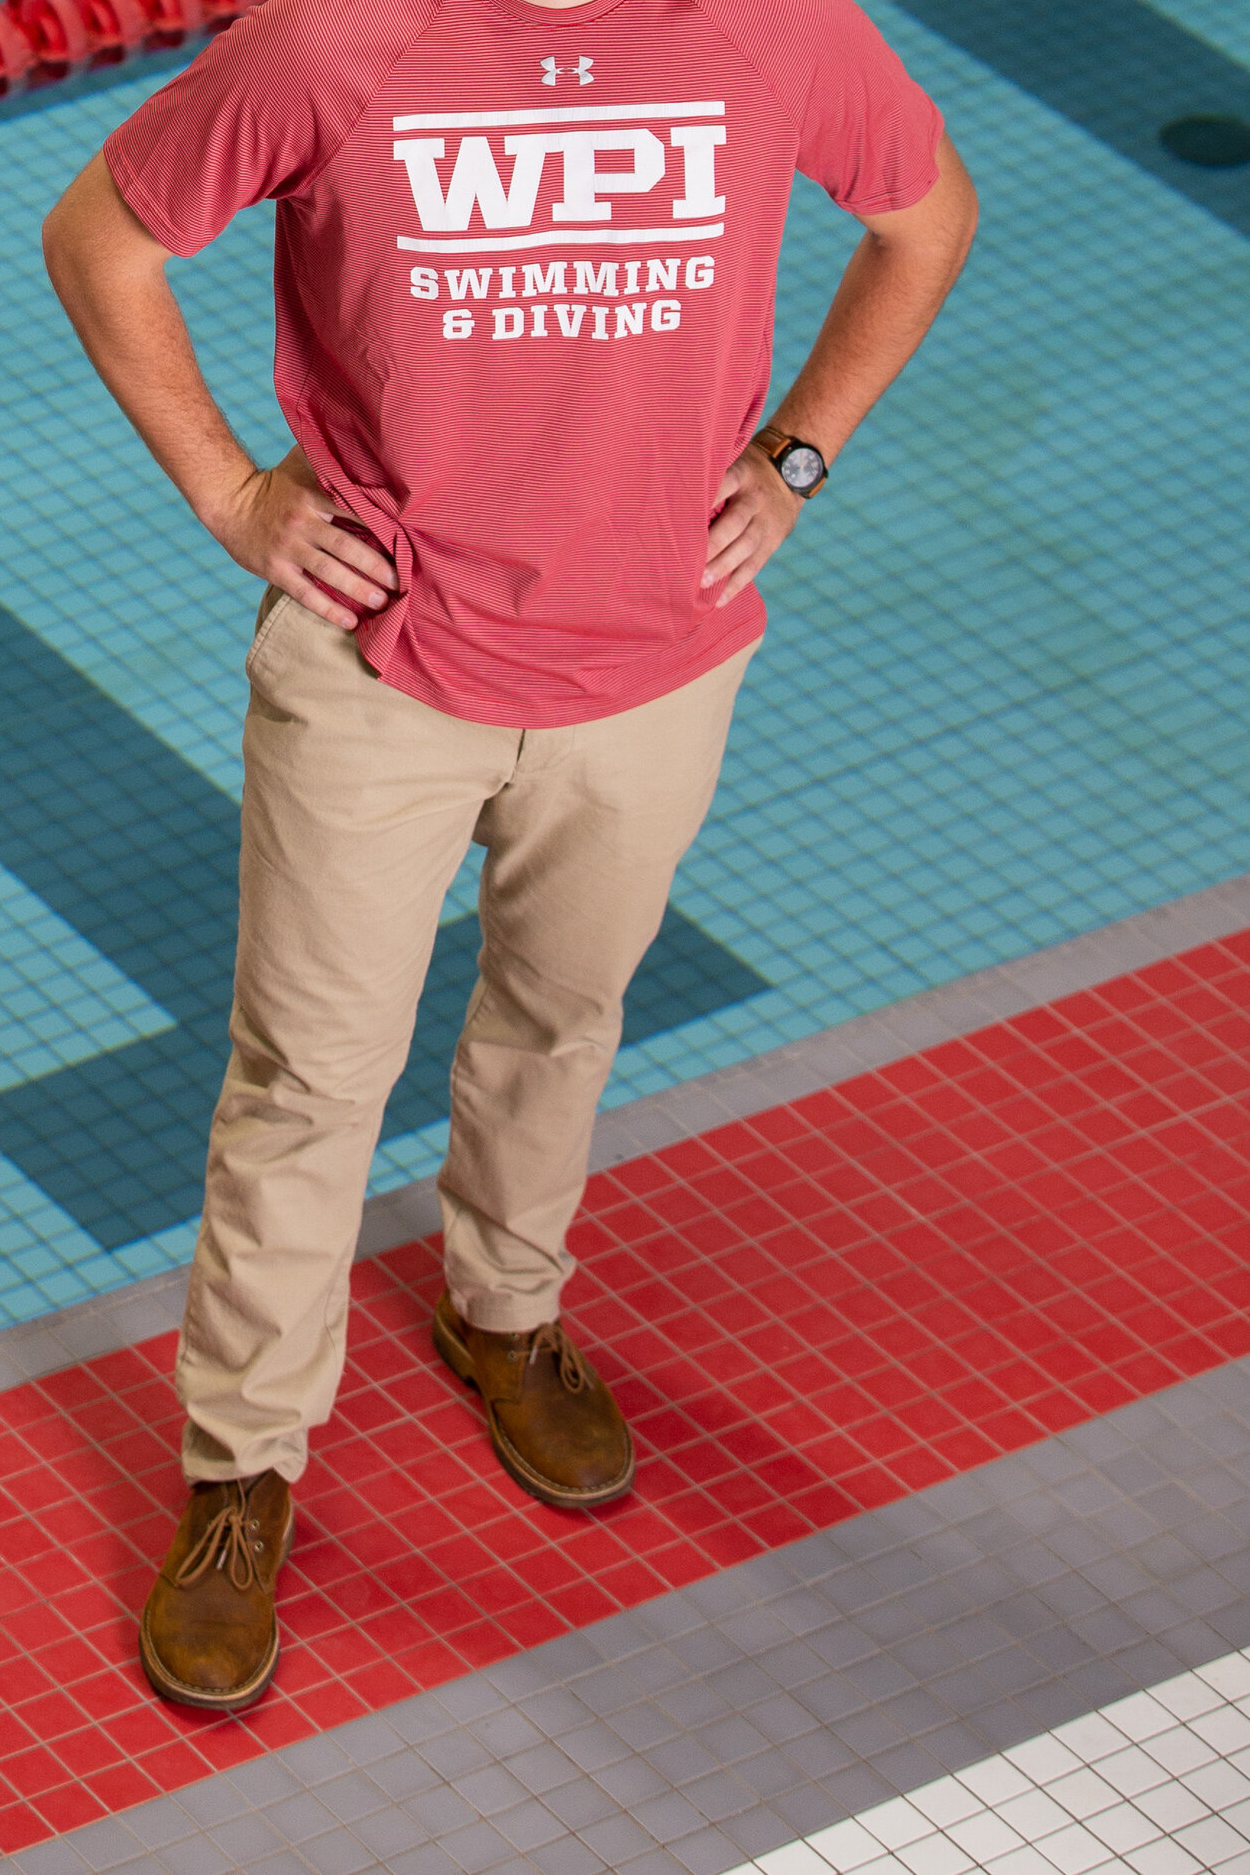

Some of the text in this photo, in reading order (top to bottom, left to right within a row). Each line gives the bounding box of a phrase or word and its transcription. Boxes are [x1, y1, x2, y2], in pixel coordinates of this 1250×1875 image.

[393, 125, 727, 231] WPI
[410, 255, 715, 300] SWIMMING
[442, 299, 681, 340] & DIVING
